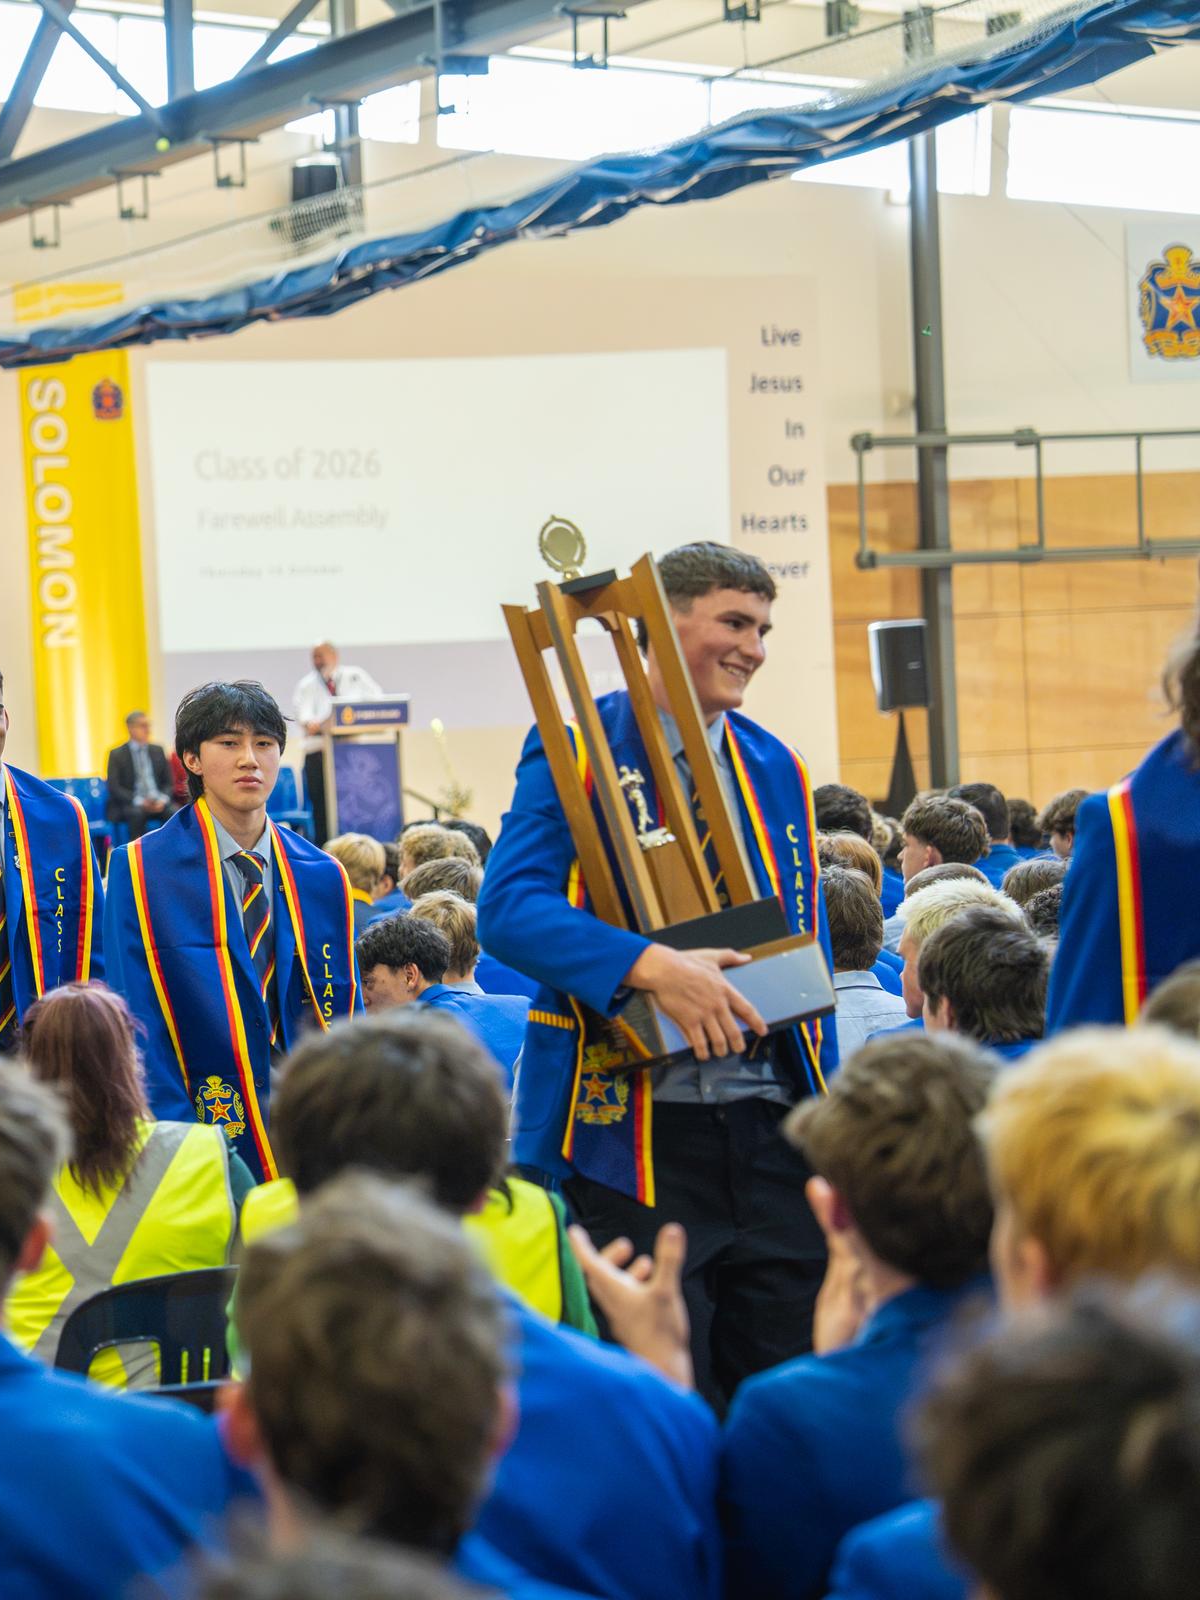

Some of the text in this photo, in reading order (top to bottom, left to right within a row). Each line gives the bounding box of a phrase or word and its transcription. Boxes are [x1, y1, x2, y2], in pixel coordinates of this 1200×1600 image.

[760, 323, 802, 346] Live
[749, 373, 803, 394] Jesus
[785, 419, 805, 440] In
[194, 446, 382, 481] Class of 2026
[768, 464, 806, 487] Our
[28, 378, 80, 650] SOLOMON
[197, 504, 390, 532] Farewell Assembly
[741, 513, 808, 534] Hearts
[785, 823, 806, 935] CLASS
[54, 867, 65, 953] CLASS
[322, 943, 334, 1025] CLAS
